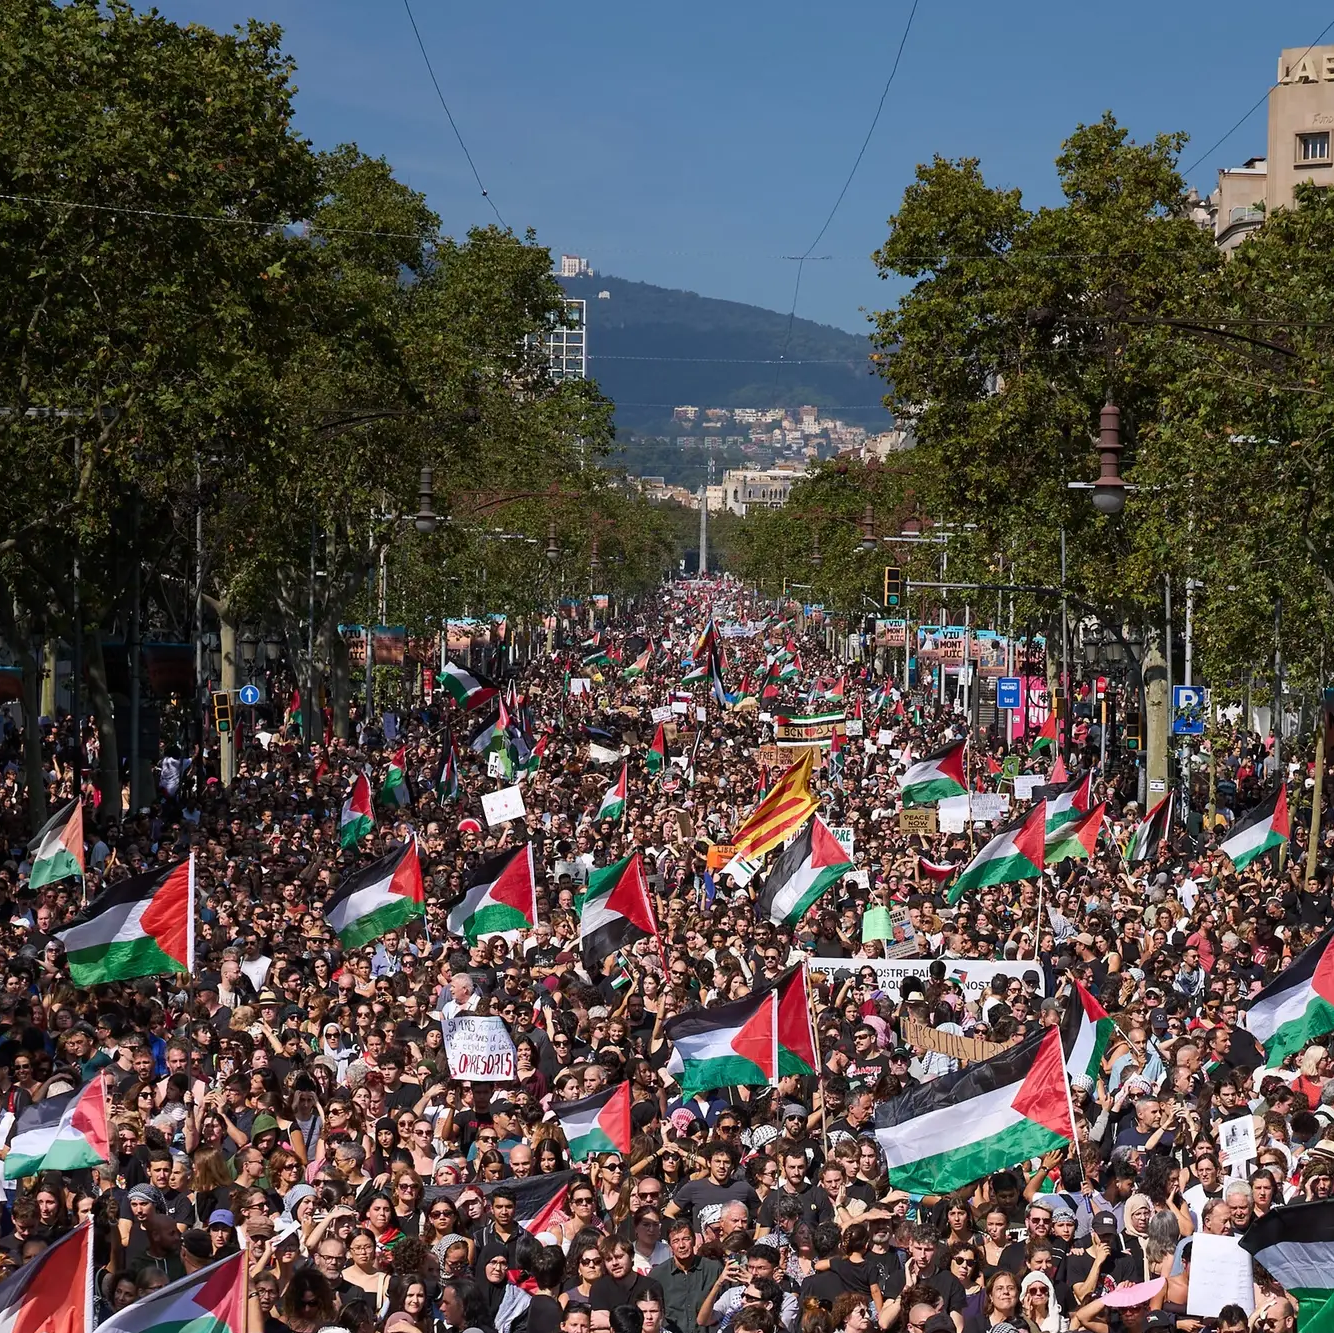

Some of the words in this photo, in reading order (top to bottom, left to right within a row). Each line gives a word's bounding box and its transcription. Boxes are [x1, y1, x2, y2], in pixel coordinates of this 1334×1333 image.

[1278, 55, 1317, 83] LA
[942, 632, 959, 642] VIU
[940, 641, 962, 651] MONT
[784, 727, 803, 739] BCN
[459, 1053, 511, 1076] OPRESORES
